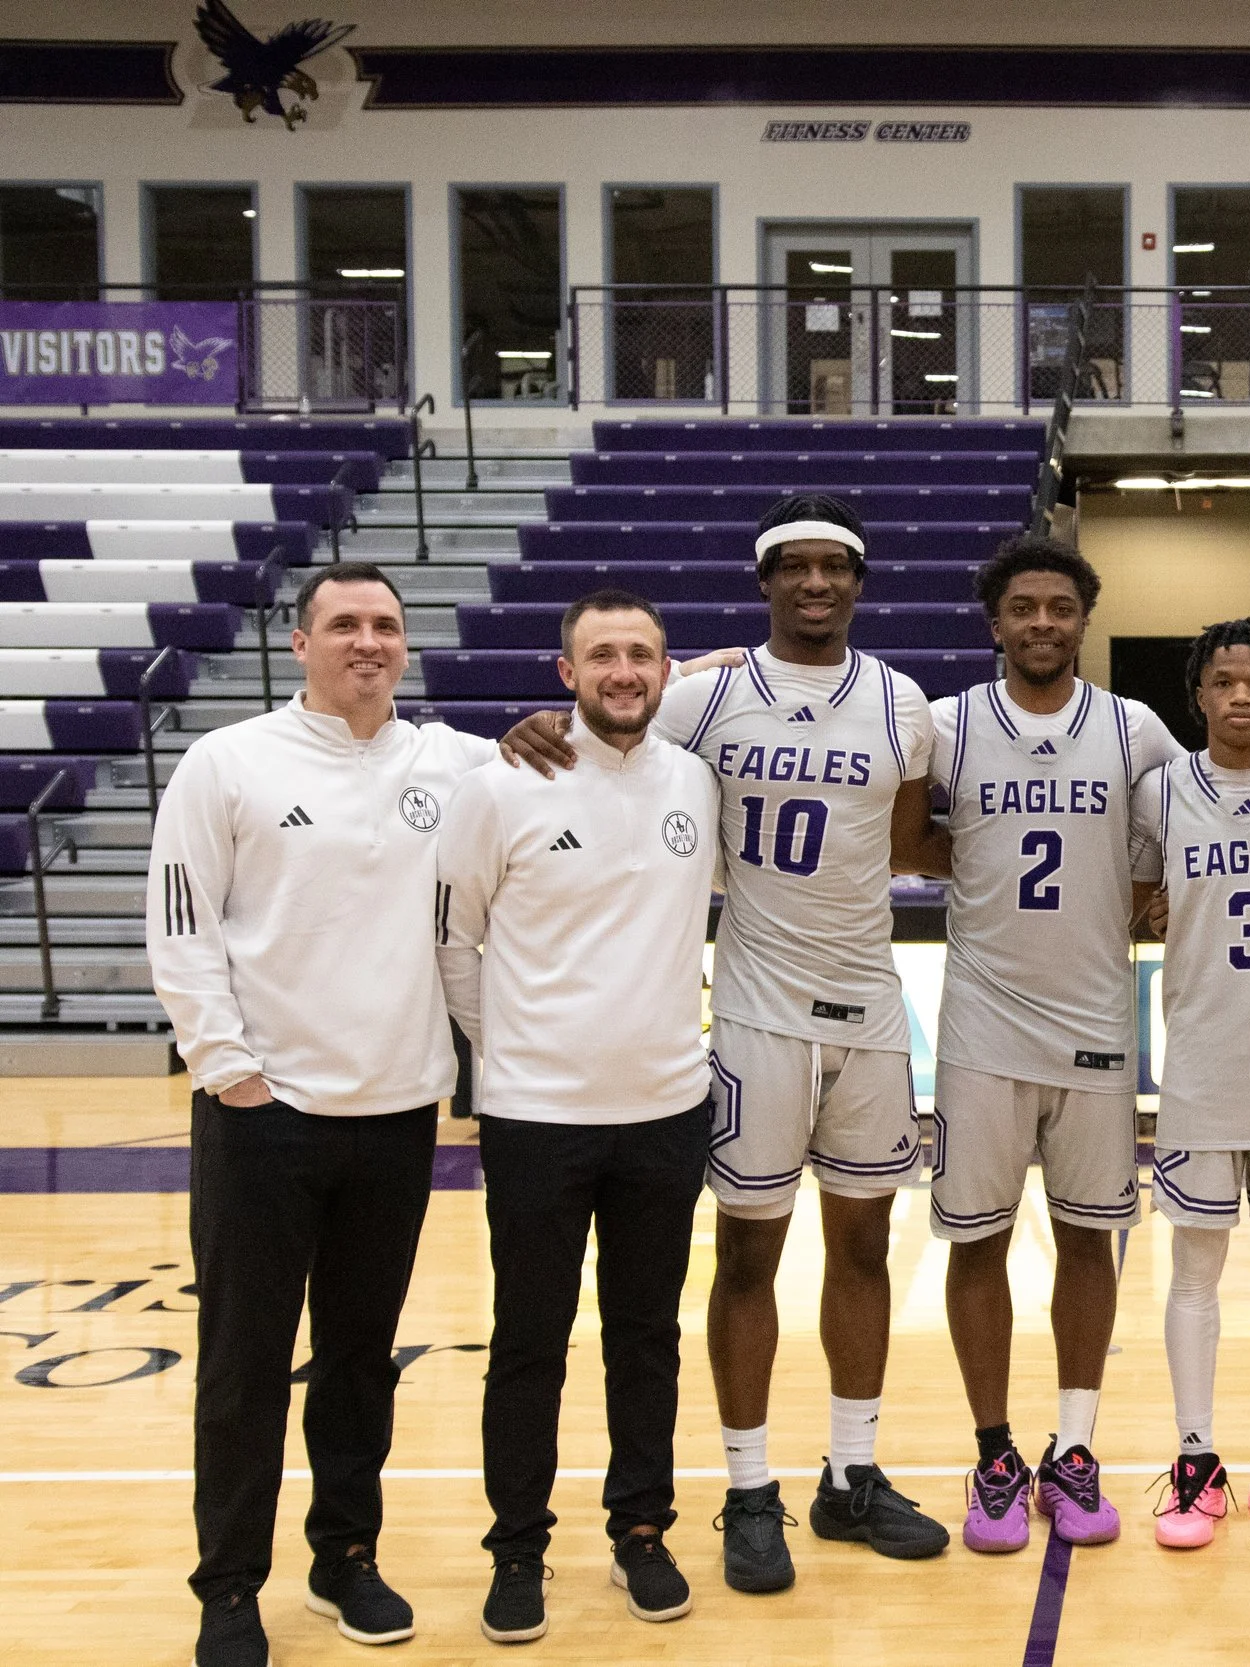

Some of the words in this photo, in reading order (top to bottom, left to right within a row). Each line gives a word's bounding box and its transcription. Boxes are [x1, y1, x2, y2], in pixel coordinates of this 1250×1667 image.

[761, 120, 871, 141] FITNESS
[874, 121, 971, 142] CENTER
[0, 330, 165, 375] VISITORS
[718, 743, 871, 786] EAGLES
[979, 779, 1108, 815] EAGLES
[740, 796, 828, 877] 10
[1018, 829, 1063, 911] 2
